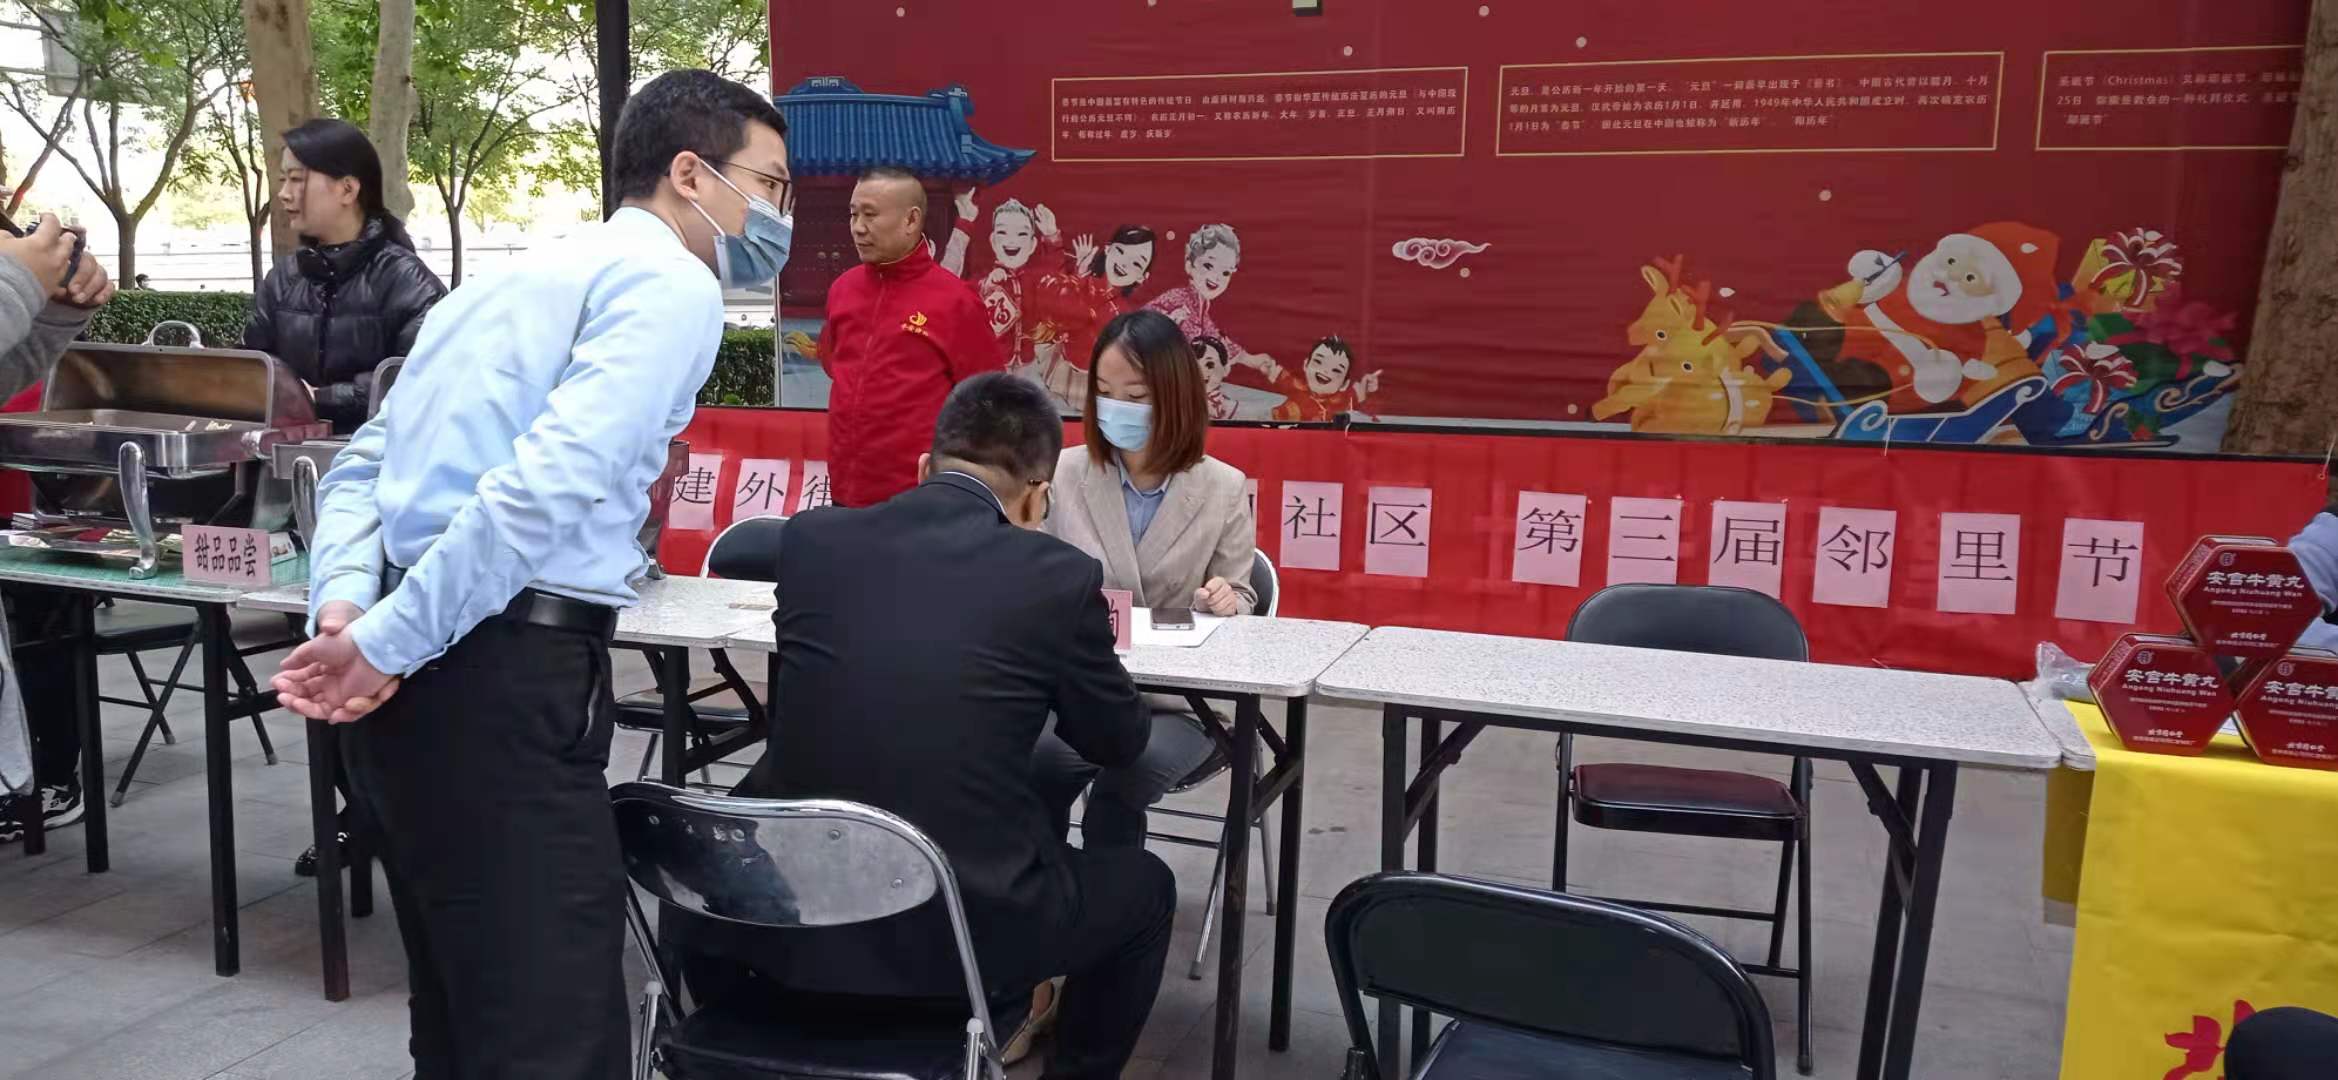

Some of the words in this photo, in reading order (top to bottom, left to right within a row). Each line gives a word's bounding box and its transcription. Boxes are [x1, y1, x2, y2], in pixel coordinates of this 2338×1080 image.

[987, 297, 1011, 326] 福
[195, 533, 257, 577] 甜品品尝
[1284, 496, 1427, 546] 社区
[1521, 508, 2139, 587] 第三届邻里节
[2206, 571, 2305, 588] 安宫牛黄丸
[2125, 669, 2219, 688] 安宫牛黄丸
